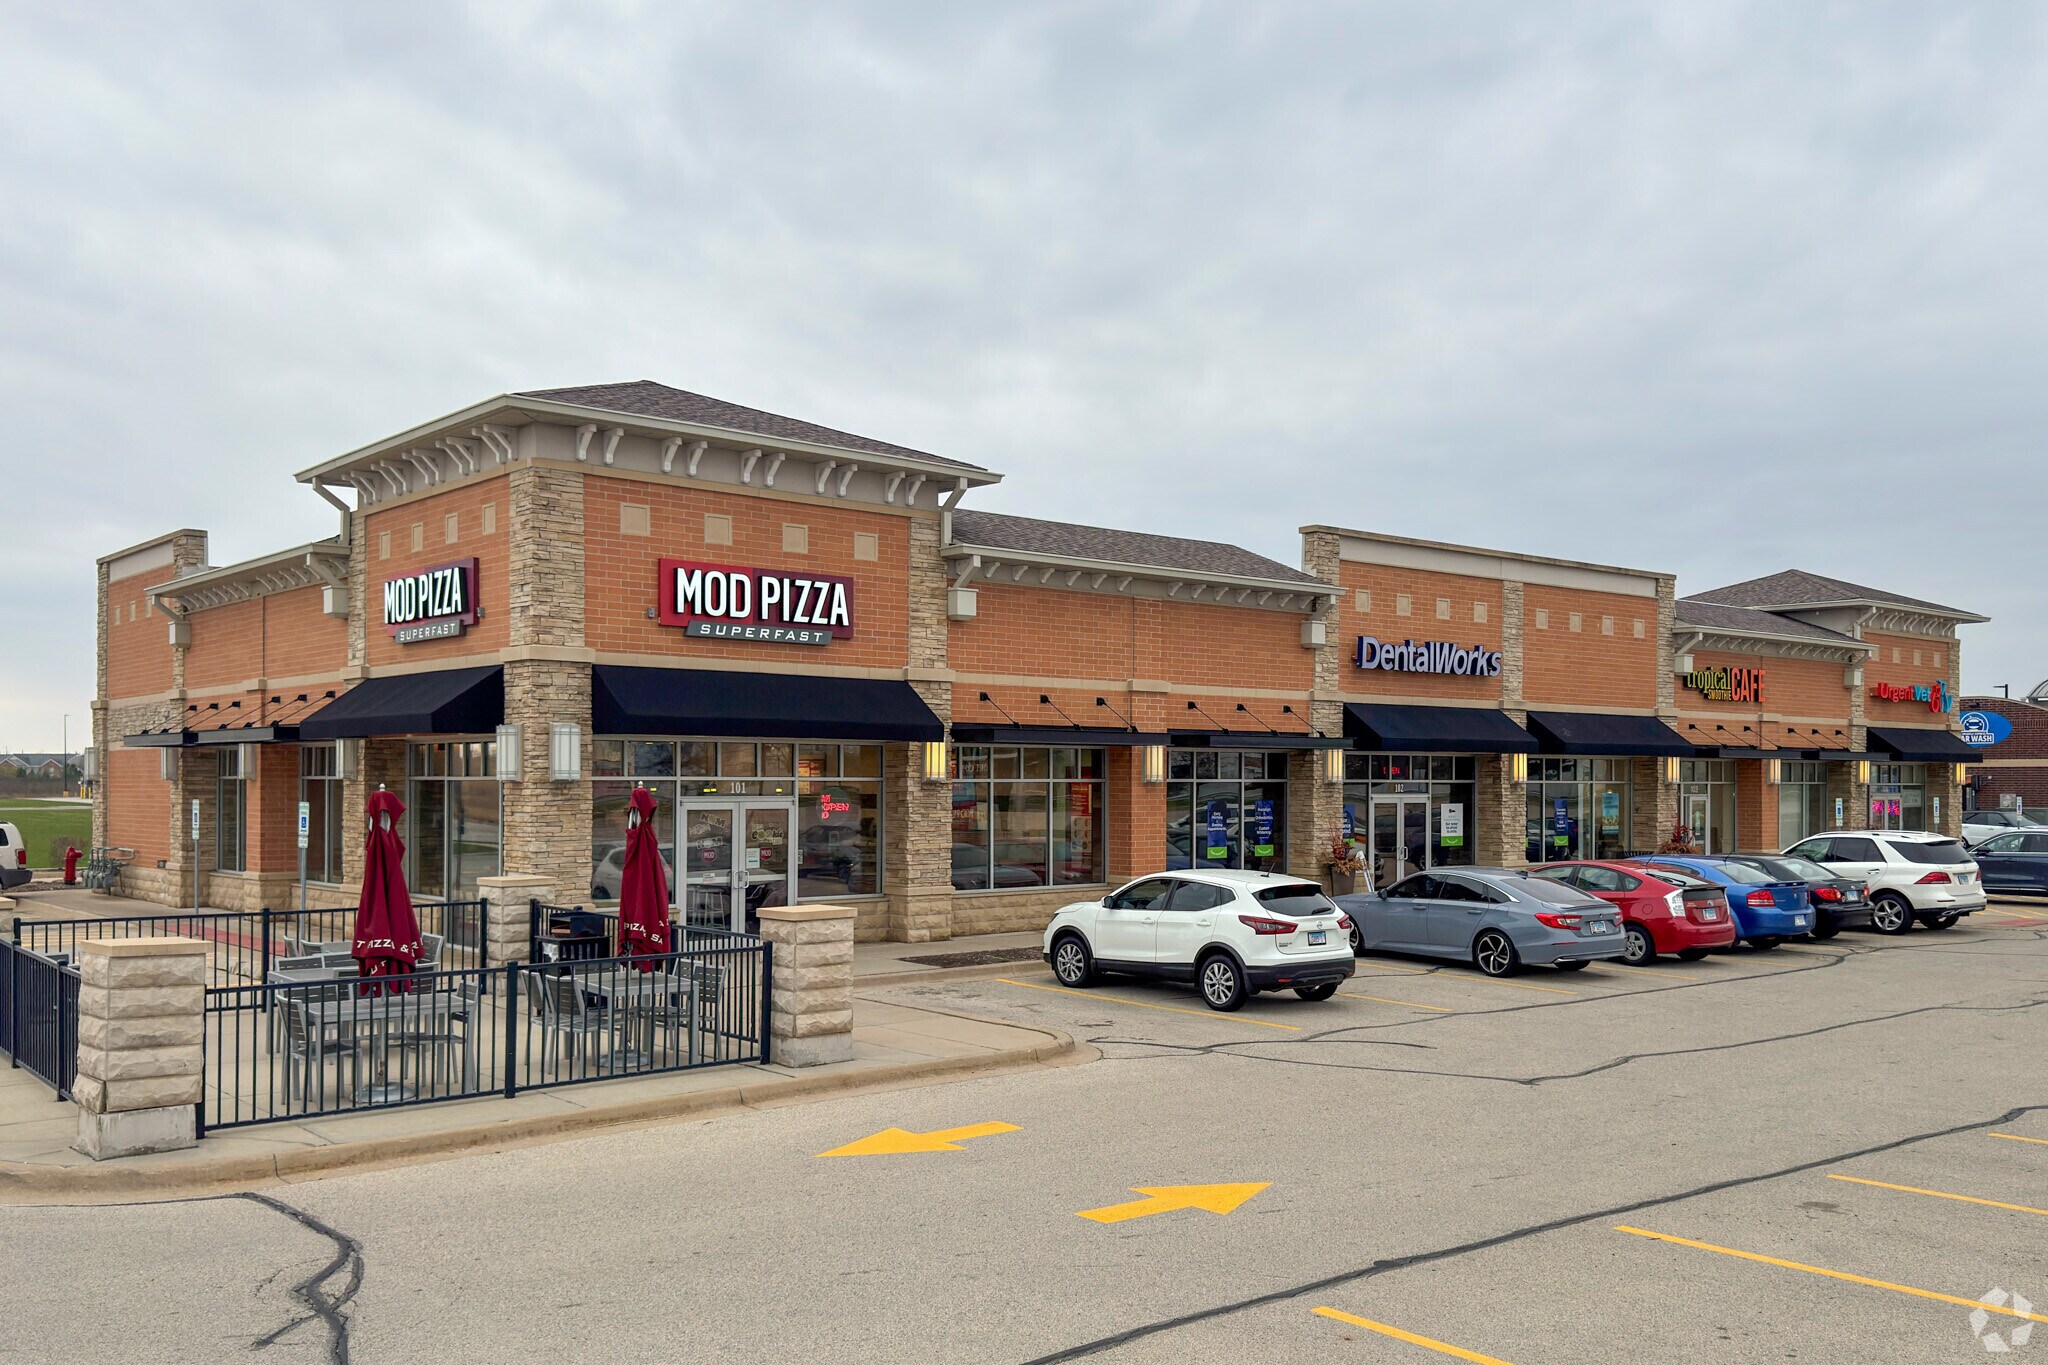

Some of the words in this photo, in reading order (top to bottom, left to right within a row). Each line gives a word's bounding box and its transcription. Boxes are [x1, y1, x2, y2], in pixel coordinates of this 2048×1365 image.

[384, 577, 416, 624] MOD
[418, 567, 462, 619] PIZZA
[675, 567, 751, 618] MOD
[760, 575, 850, 626] PIZZA
[400, 623, 456, 641] SUPERFAST
[700, 624, 824, 643] SUPERFAST
[1357, 636, 1502, 677] DentalWorks
[1687, 667, 1731, 693] tropical
[1731, 667, 1766, 702] CAFE
[1960, 734, 1971, 743] AR
[1971, 735, 1992, 743] WASH
[730, 782, 746, 794] 101
[1395, 784, 1404, 793] 102
[704, 851, 715, 859] MOD
[761, 849, 772, 858] MOD
